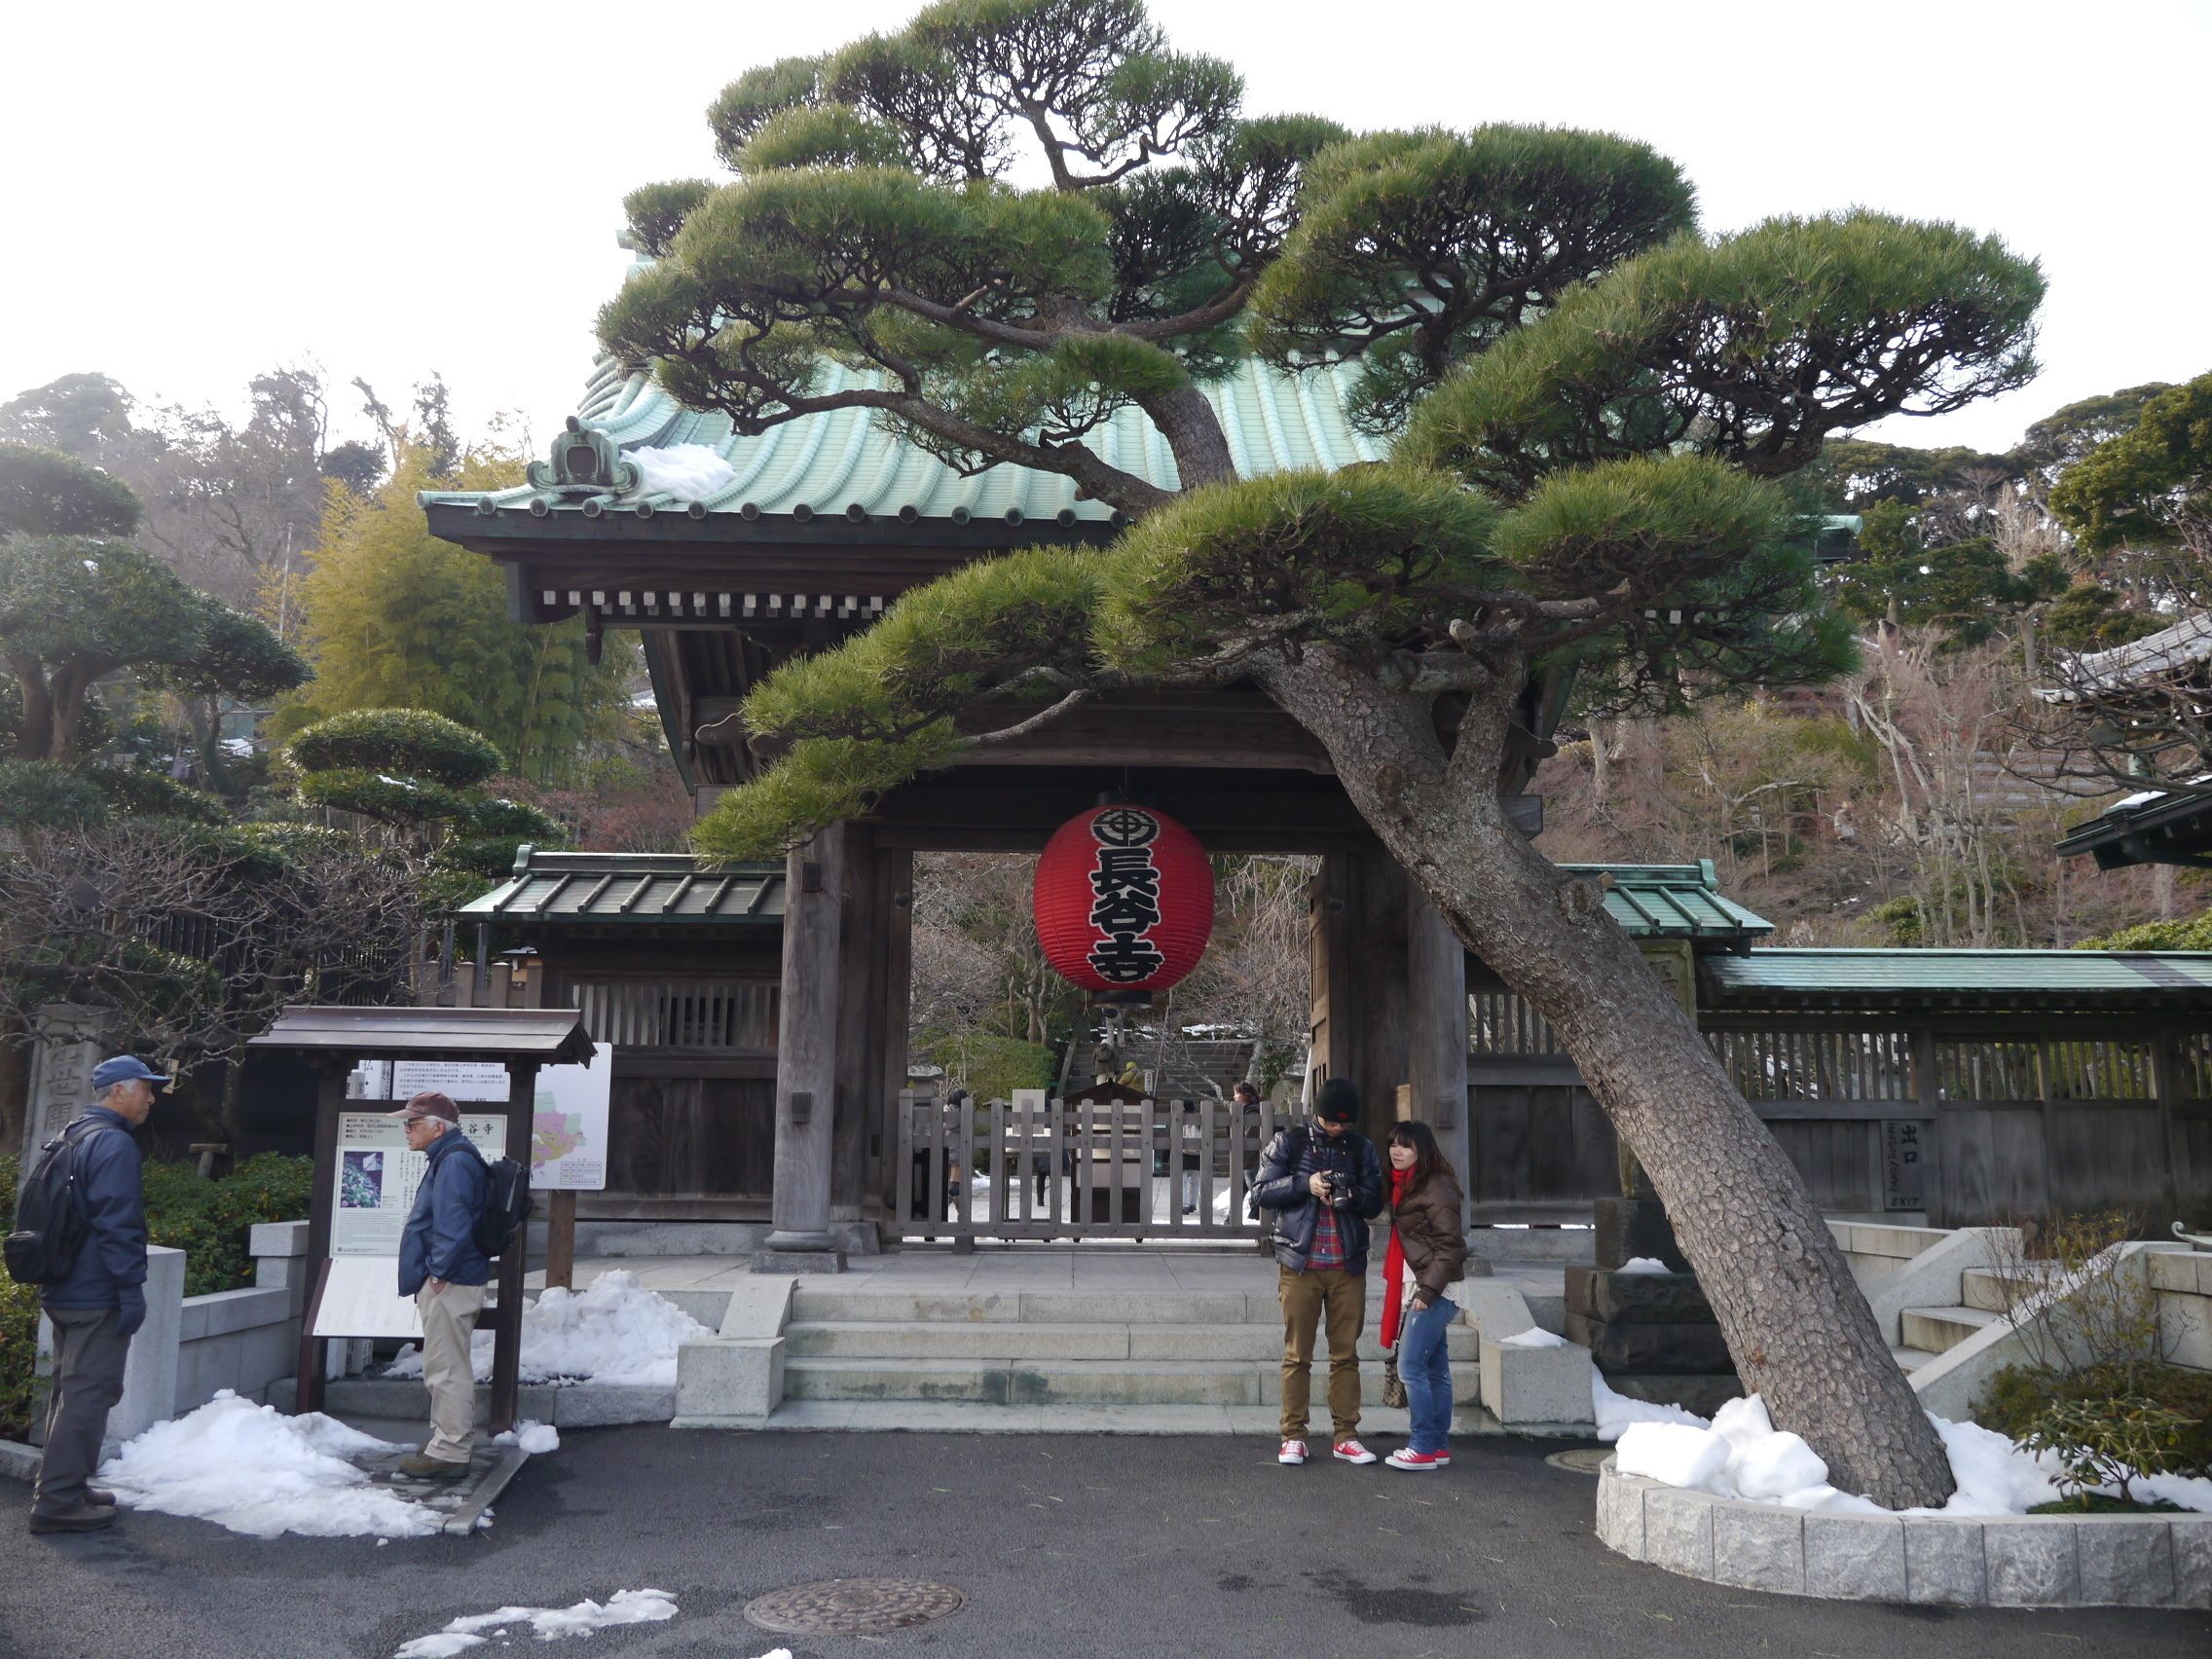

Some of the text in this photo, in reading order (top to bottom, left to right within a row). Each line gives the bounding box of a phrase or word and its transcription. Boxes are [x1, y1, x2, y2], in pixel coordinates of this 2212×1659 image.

[1089, 847, 1163, 983] 長谷寺
[1900, 1124, 1919, 1164] 出口
[1891, 1198, 1920, 1207] EXIT
